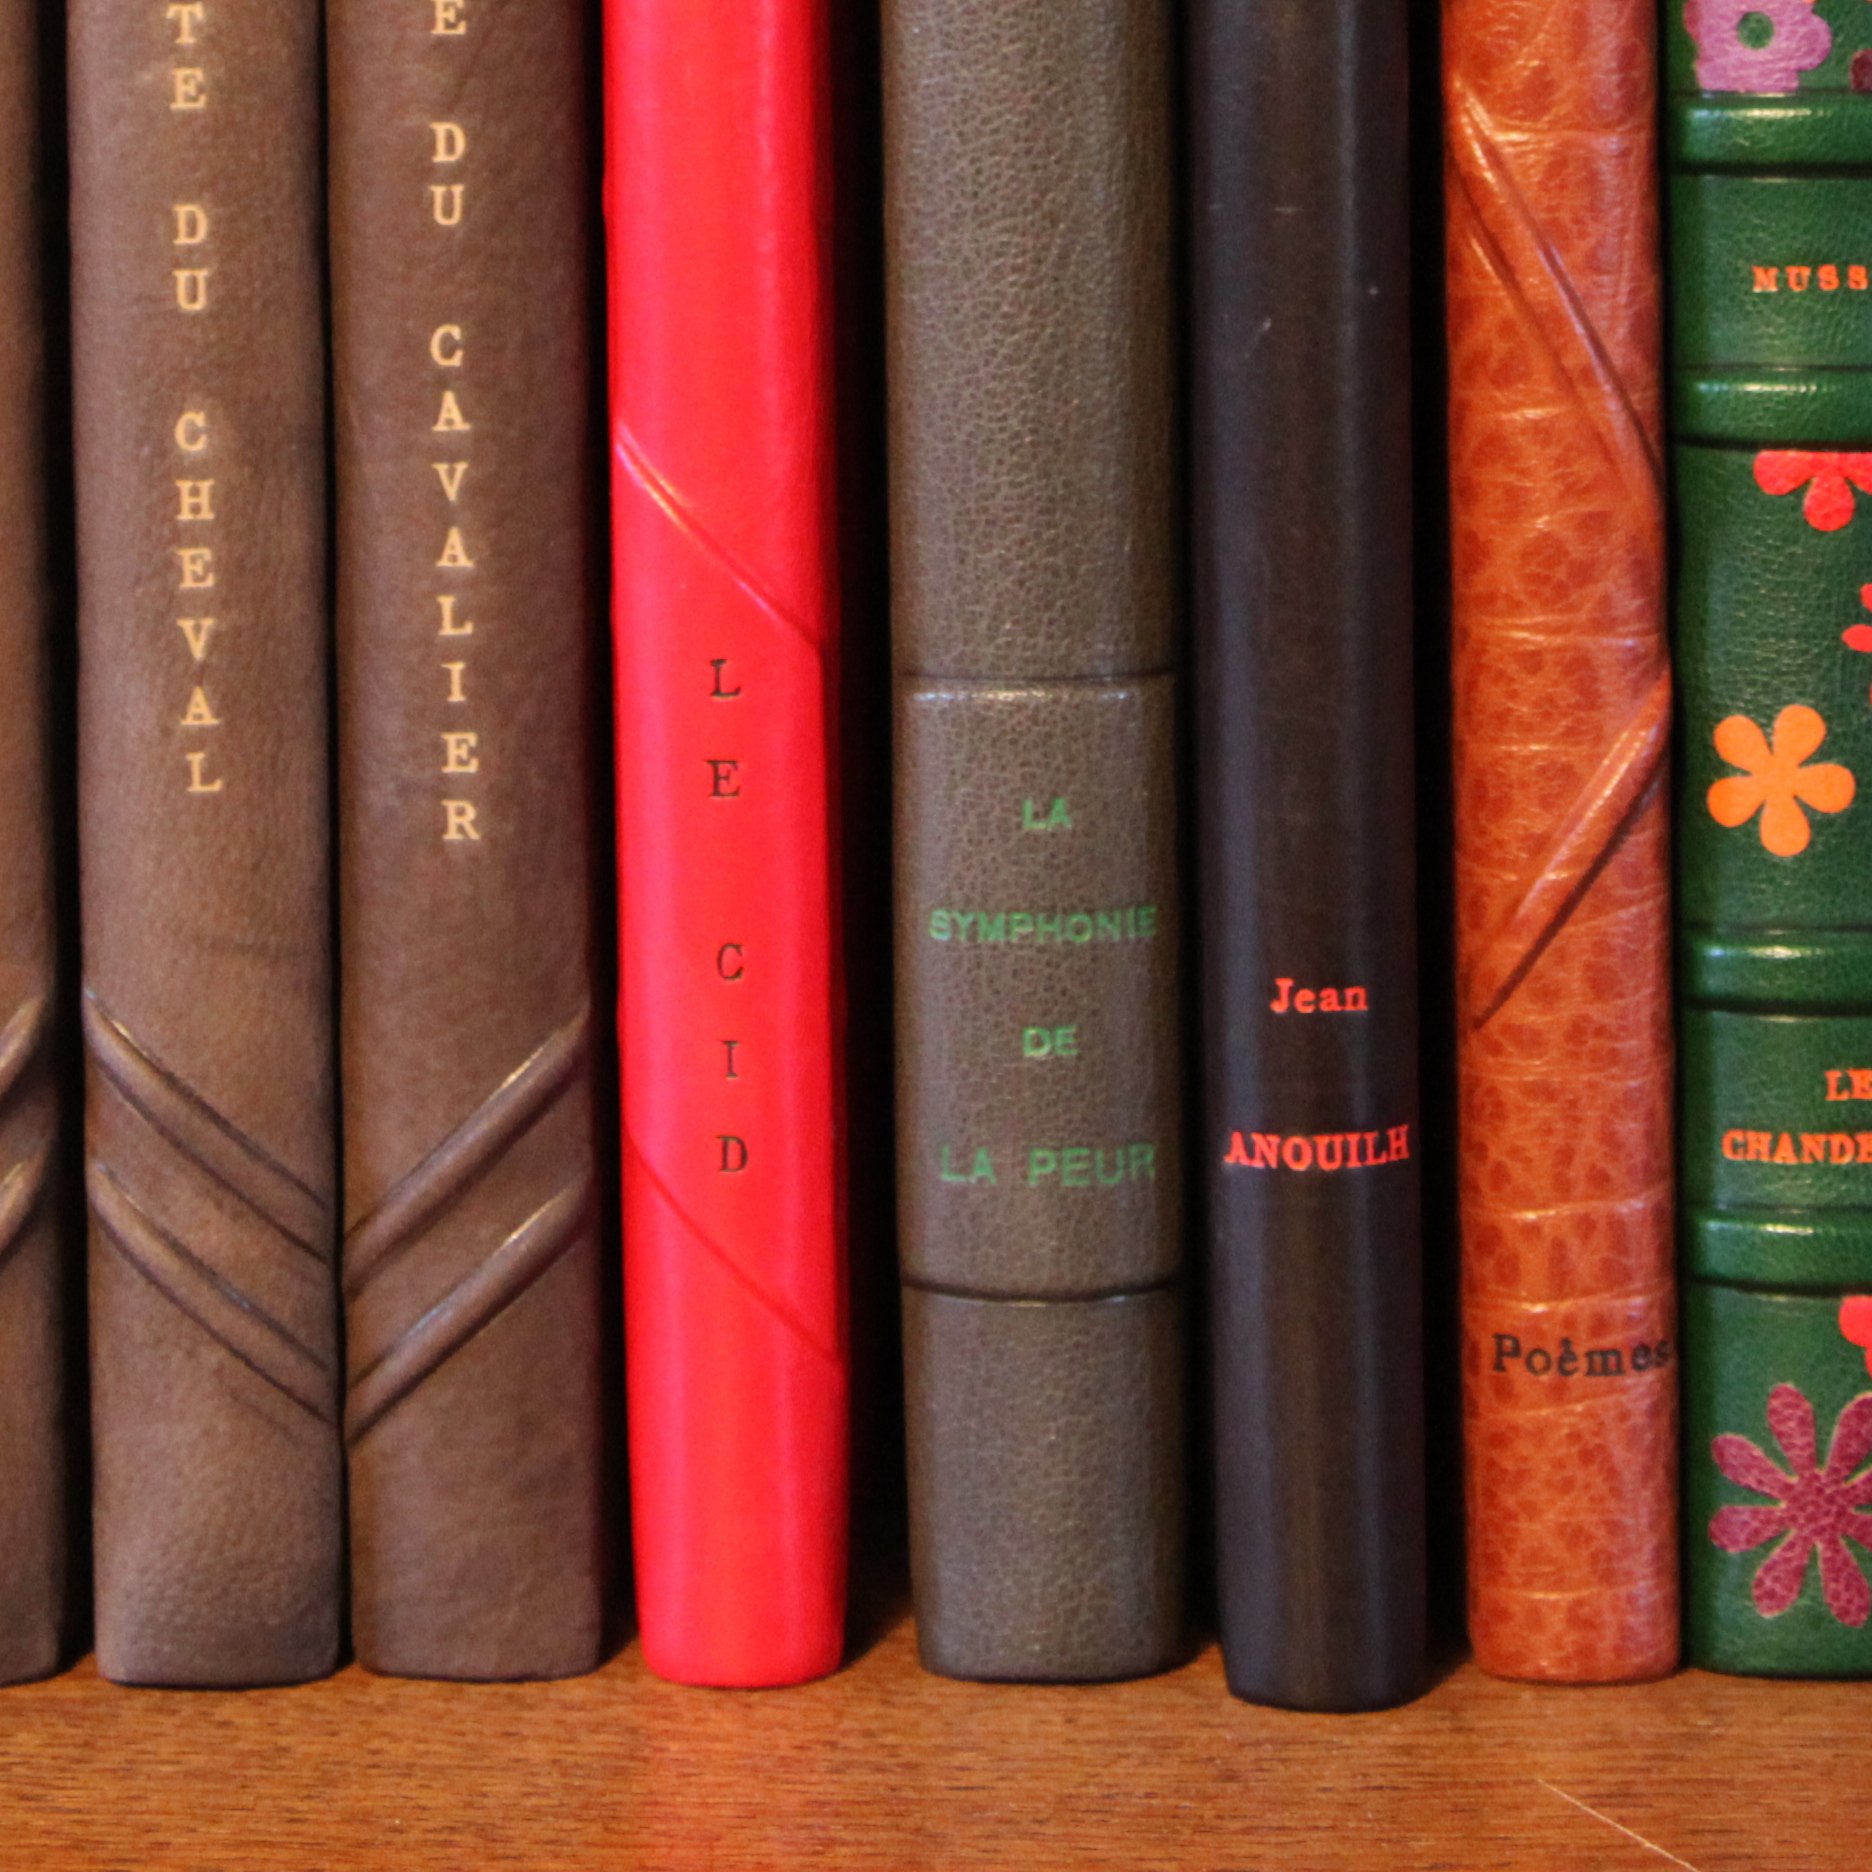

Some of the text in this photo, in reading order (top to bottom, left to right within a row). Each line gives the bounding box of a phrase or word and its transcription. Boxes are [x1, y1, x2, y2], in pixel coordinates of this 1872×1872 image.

[430, 123, 468, 227] DU
[173, 204, 209, 312] DU
[174, 412, 223, 794] CHEVAL
[430, 326, 481, 841] CAVALIER
[1023, 797, 1072, 830] LA
[708, 659, 749, 1174] LE CID
[929, 905, 1158, 943] SYMPHONIE
[1269, 977, 1369, 1013] Jean
[1023, 1025, 1078, 1057] DE
[940, 1143, 1156, 1186] LA PEUR
[1223, 1124, 1409, 1171] ANOUILH
